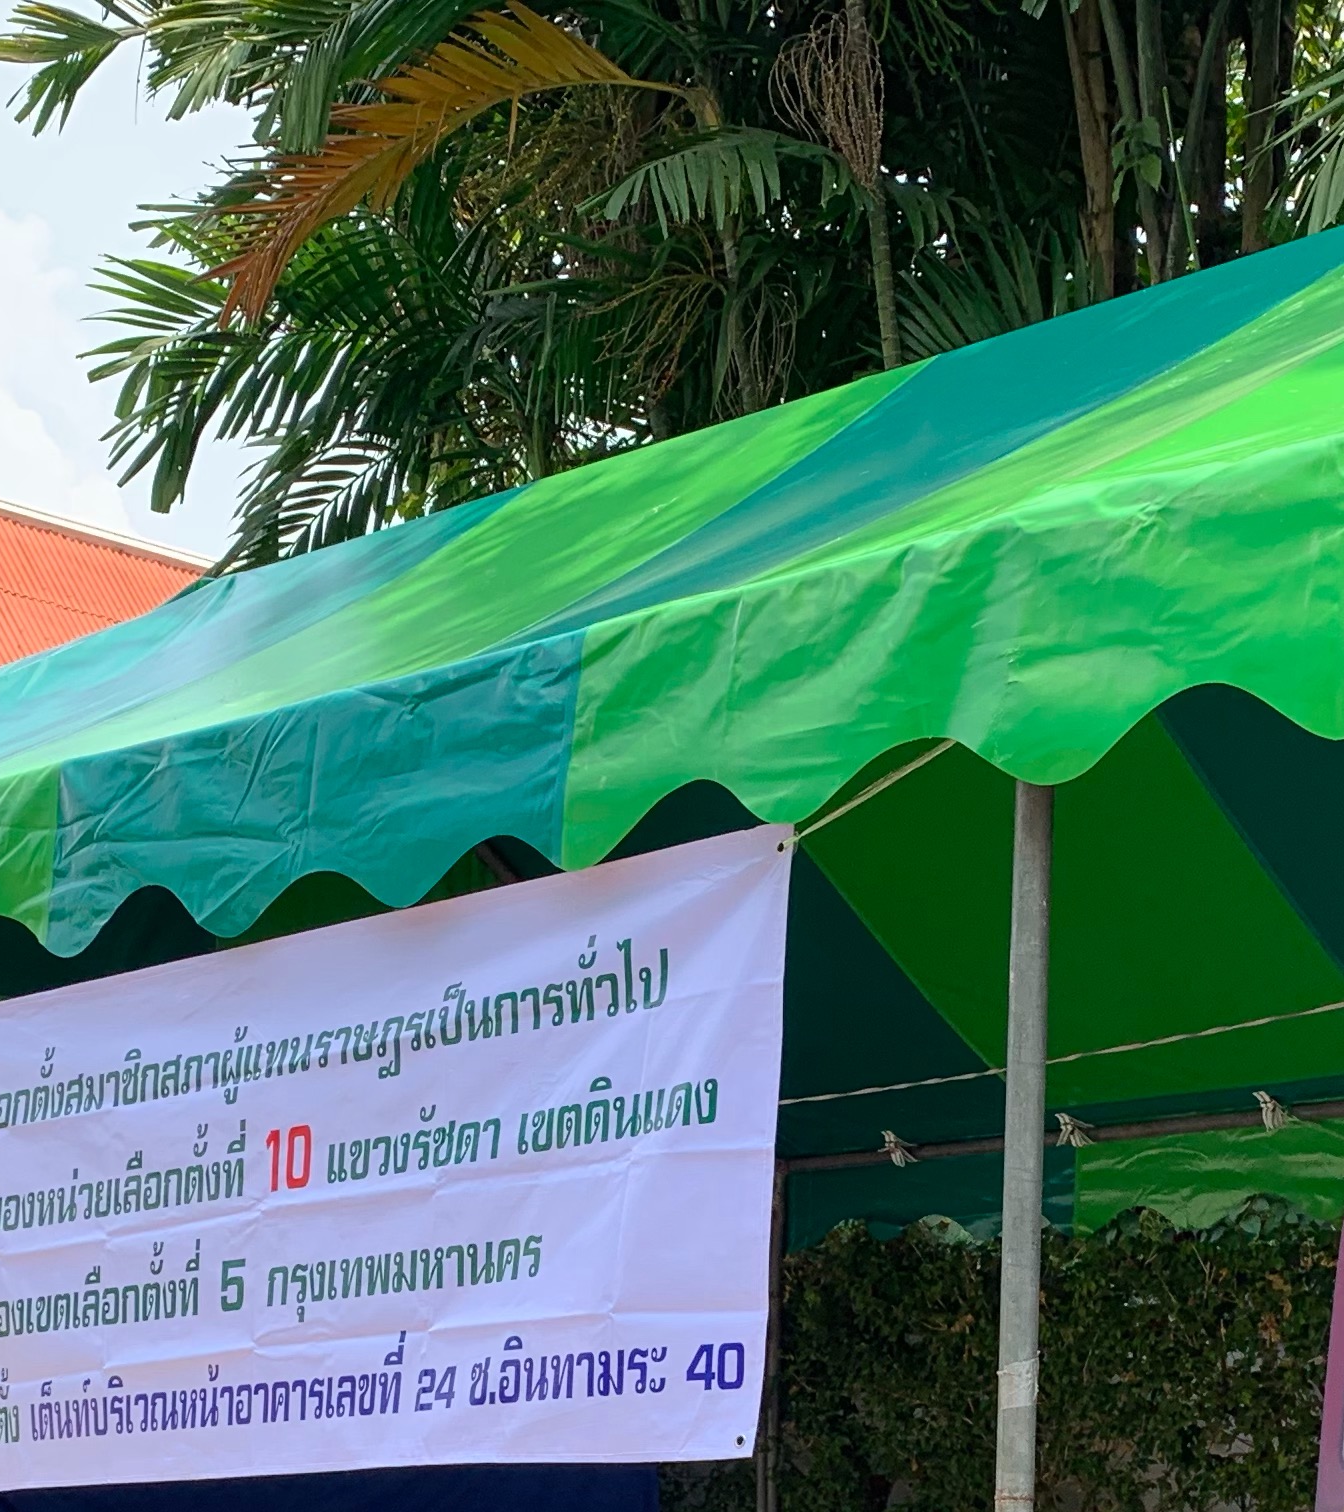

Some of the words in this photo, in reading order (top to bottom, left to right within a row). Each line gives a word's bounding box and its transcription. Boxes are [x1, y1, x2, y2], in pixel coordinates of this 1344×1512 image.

[265, 1124, 313, 1193] 10
[326, 1103, 502, 1184] แขวงรัชดา
[517, 1075, 719, 1156] เขตดินแดง
[220, 1258, 247, 1313] 5
[266, 1234, 543, 1323] กรุงเทพมหานคร
[30, 1330, 407, 1442] เต็นท์บริเวณหน้าอาคารเลขที่
[414, 1365, 457, 1413] 24
[469, 1335, 667, 1407] ซ.อินทามระ
[685, 1341, 745, 1391] 40
